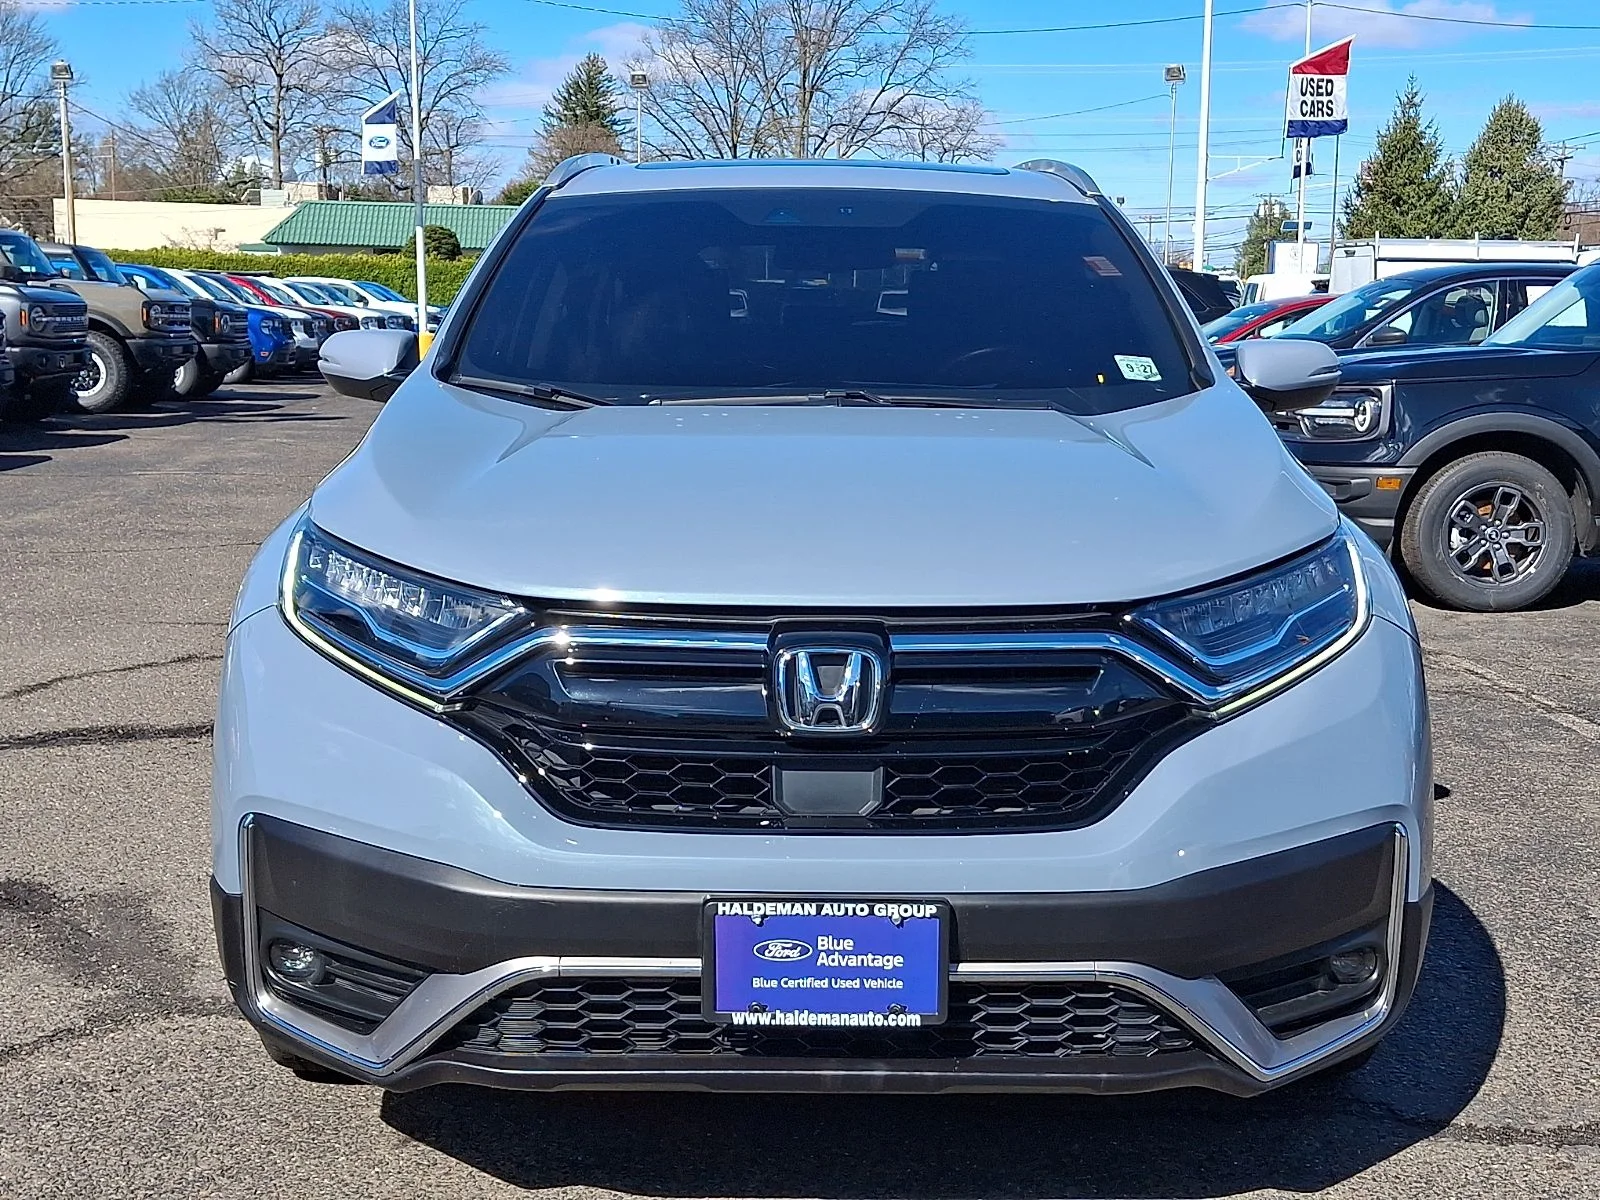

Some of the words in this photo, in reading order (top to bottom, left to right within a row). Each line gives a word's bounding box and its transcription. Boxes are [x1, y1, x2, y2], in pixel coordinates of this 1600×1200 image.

[1300, 77, 1334, 97] USED
[1300, 99, 1334, 118] CARS
[1126, 363, 1134, 373] 9
[1140, 364, 1153, 375] 27
[717, 902, 817, 916] HALDEMAN
[821, 903, 869, 917] AUTO
[873, 904, 938, 918] GROUP
[764, 942, 801, 958] Ford
[817, 935, 854, 951] Blue
[816, 952, 904, 970] Advantage
[752, 977, 777, 988] Blue
[780, 977, 829, 989] Certified
[831, 978, 860, 989] Used
[863, 978, 904, 989] Vehicle
[731, 1009, 921, 1027] www.haldemanauto.com
